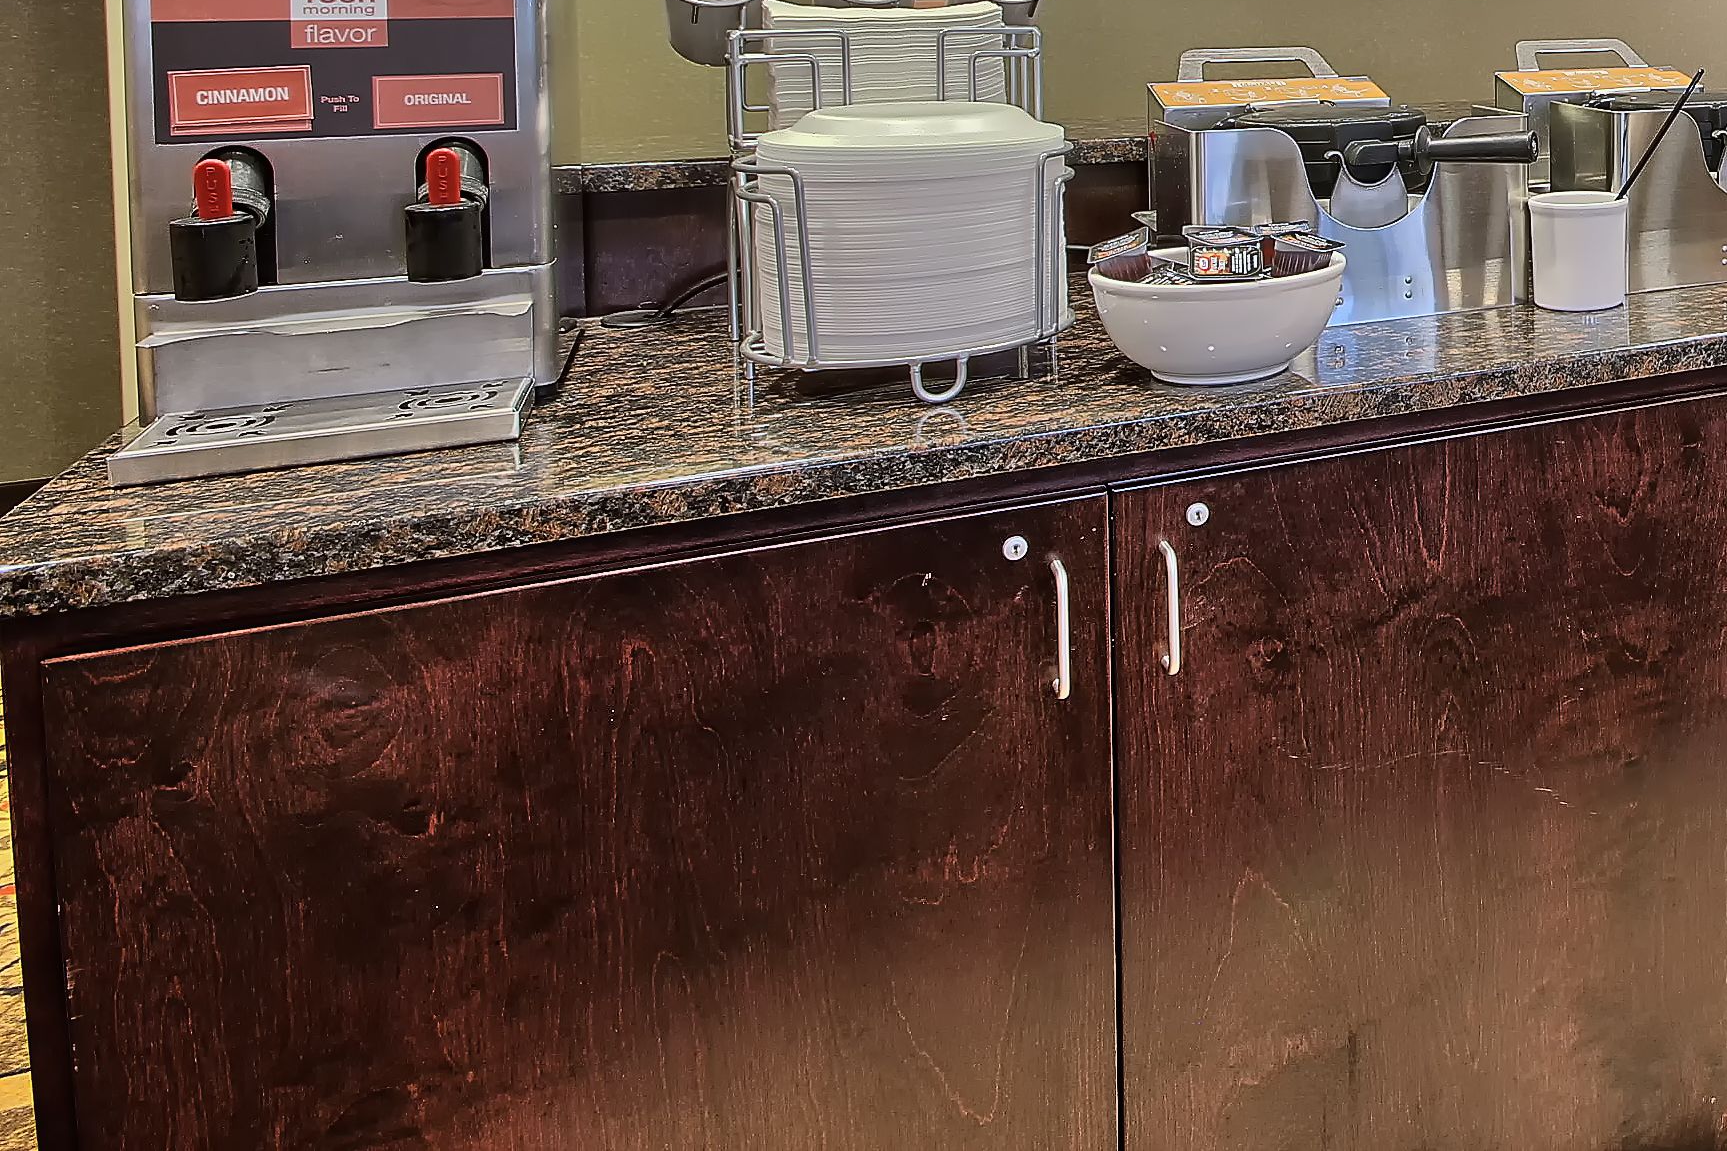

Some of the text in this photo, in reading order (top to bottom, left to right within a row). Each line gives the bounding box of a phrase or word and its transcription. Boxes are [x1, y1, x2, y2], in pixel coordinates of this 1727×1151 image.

[302, 3, 375, 16] morning
[304, 24, 377, 44] flavor
[195, 86, 290, 106] CINNAMON
[320, 95, 360, 104] Push To
[403, 92, 472, 106] ORIGINAL
[333, 104, 348, 113] Fill
